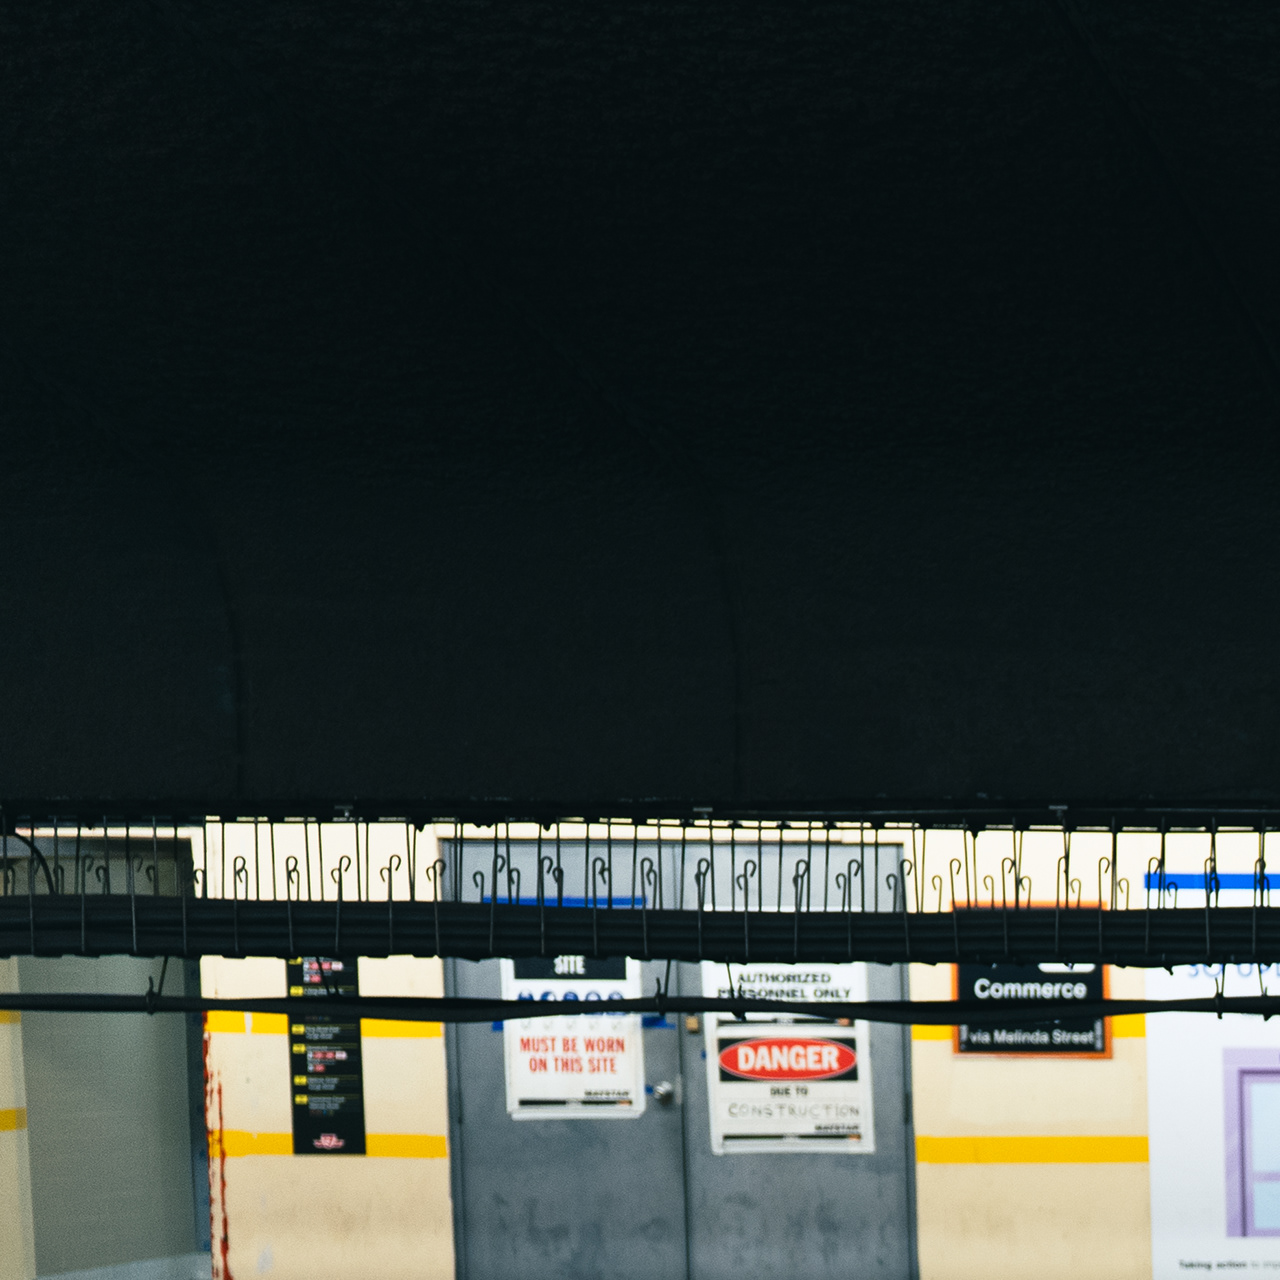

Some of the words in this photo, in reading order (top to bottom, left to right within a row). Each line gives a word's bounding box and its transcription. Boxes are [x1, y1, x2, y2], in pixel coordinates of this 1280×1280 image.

[554, 955, 585, 975] SITE
[737, 973, 832, 984] AUTHORIZED
[813, 988, 851, 1000] ONLY
[974, 977, 1087, 999] Commerce
[519, 1036, 556, 1053] MUST
[562, 1036, 578, 1053] BE
[583, 1036, 625, 1053] WORN
[970, 1029, 991, 1044] via
[993, 1029, 1049, 1045] Melinda
[1051, 1028, 1095, 1045] Street
[528, 1057, 548, 1074] ON
[553, 1057, 583, 1074] THIS
[588, 1057, 617, 1074] SITE
[737, 1044, 840, 1072] DANGER
[770, 1086, 791, 1096] DUE
[796, 1086, 809, 1096] TO
[727, 1102, 860, 1119] CONSTRUCTION
